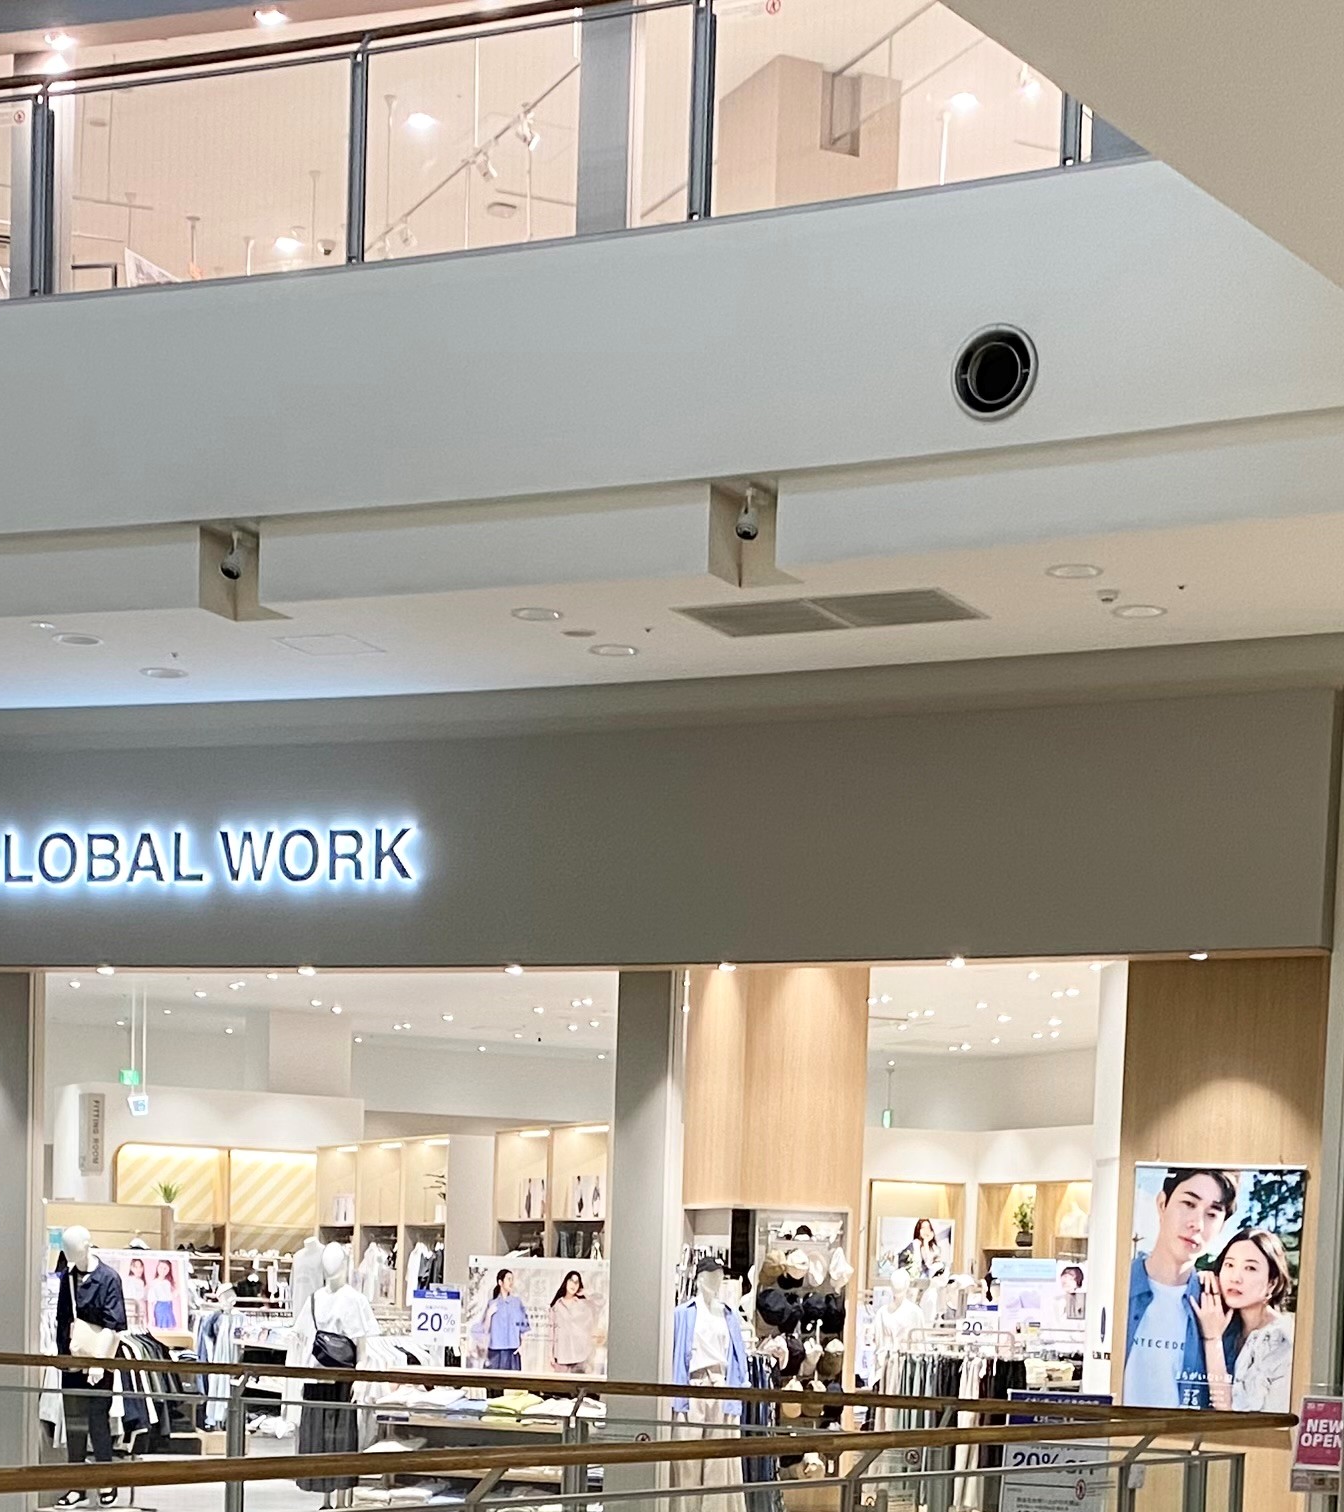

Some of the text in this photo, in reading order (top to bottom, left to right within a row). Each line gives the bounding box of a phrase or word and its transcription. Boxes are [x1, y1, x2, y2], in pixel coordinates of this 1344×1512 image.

[219, 827, 413, 881] WORK
[1306, 1418, 1344, 1433] NEW
[1300, 1433, 1342, 1448] OPEN
